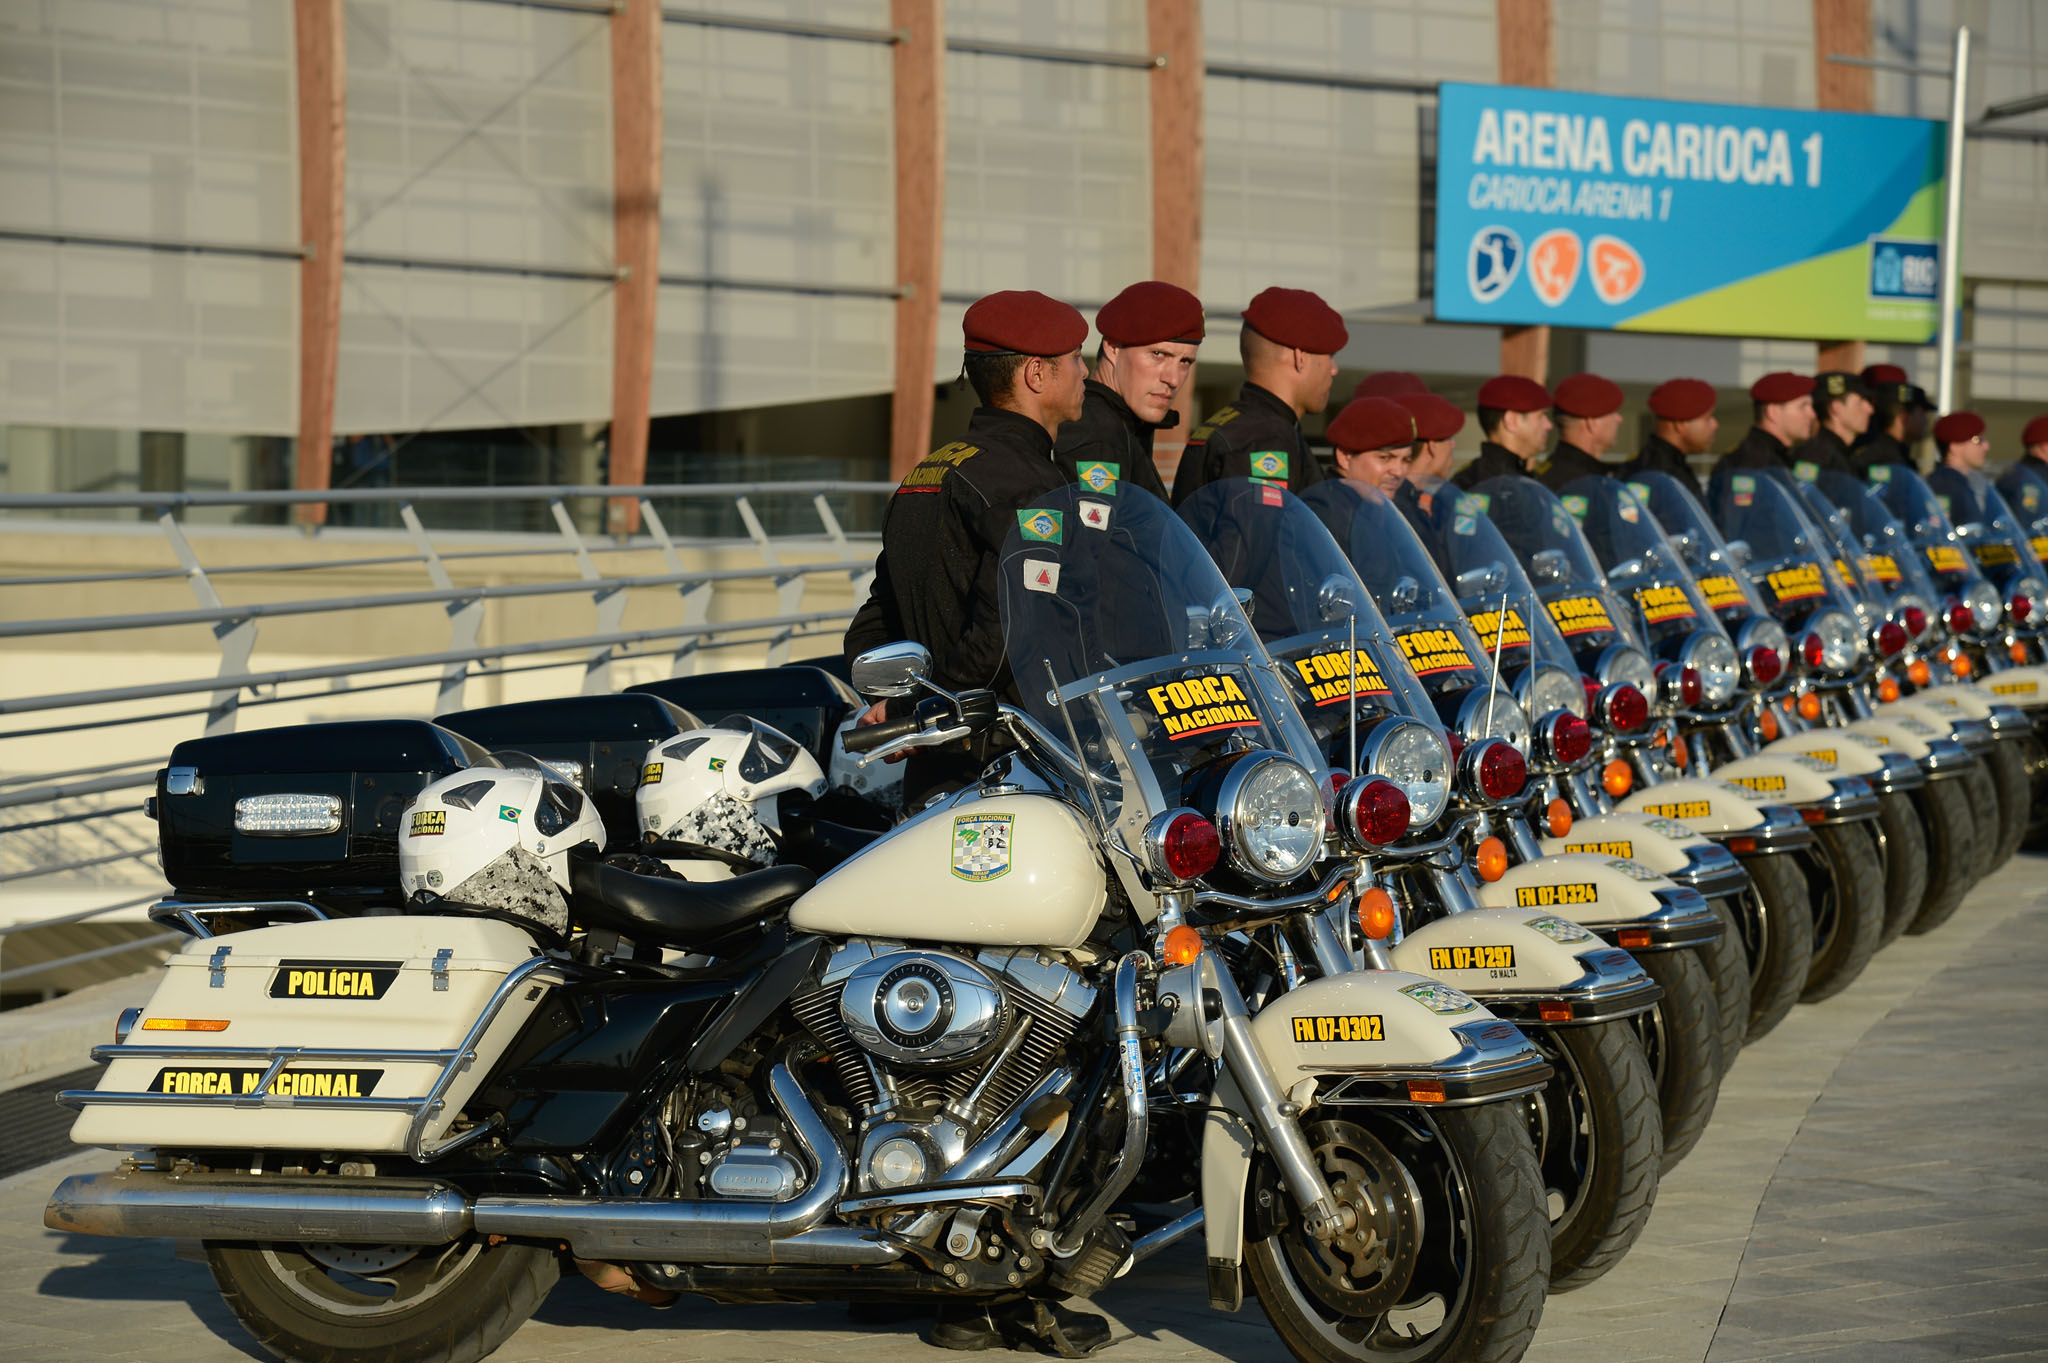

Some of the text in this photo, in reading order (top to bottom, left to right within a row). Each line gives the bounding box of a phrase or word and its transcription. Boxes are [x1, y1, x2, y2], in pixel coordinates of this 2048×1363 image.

[1472, 108, 1823, 188] ARENA CARIOCA 1
[1468, 172, 1673, 221] CARIOCA ARENA 1
[1409, 652, 1473, 672] NACIONAL
[1147, 675, 1247, 715] FORÇA
[1162, 704, 1257, 734] NACIONAL
[1518, 884, 1597, 907] FN 07-0324
[1431, 946, 1512, 969] FN 07-0297
[288, 968, 375, 996] POLÍCIA
[1498, 969, 1517, 978] MALTA
[1294, 1016, 1383, 1041] FN 07-0302
[242, 1072, 362, 1097] NCIONAL
